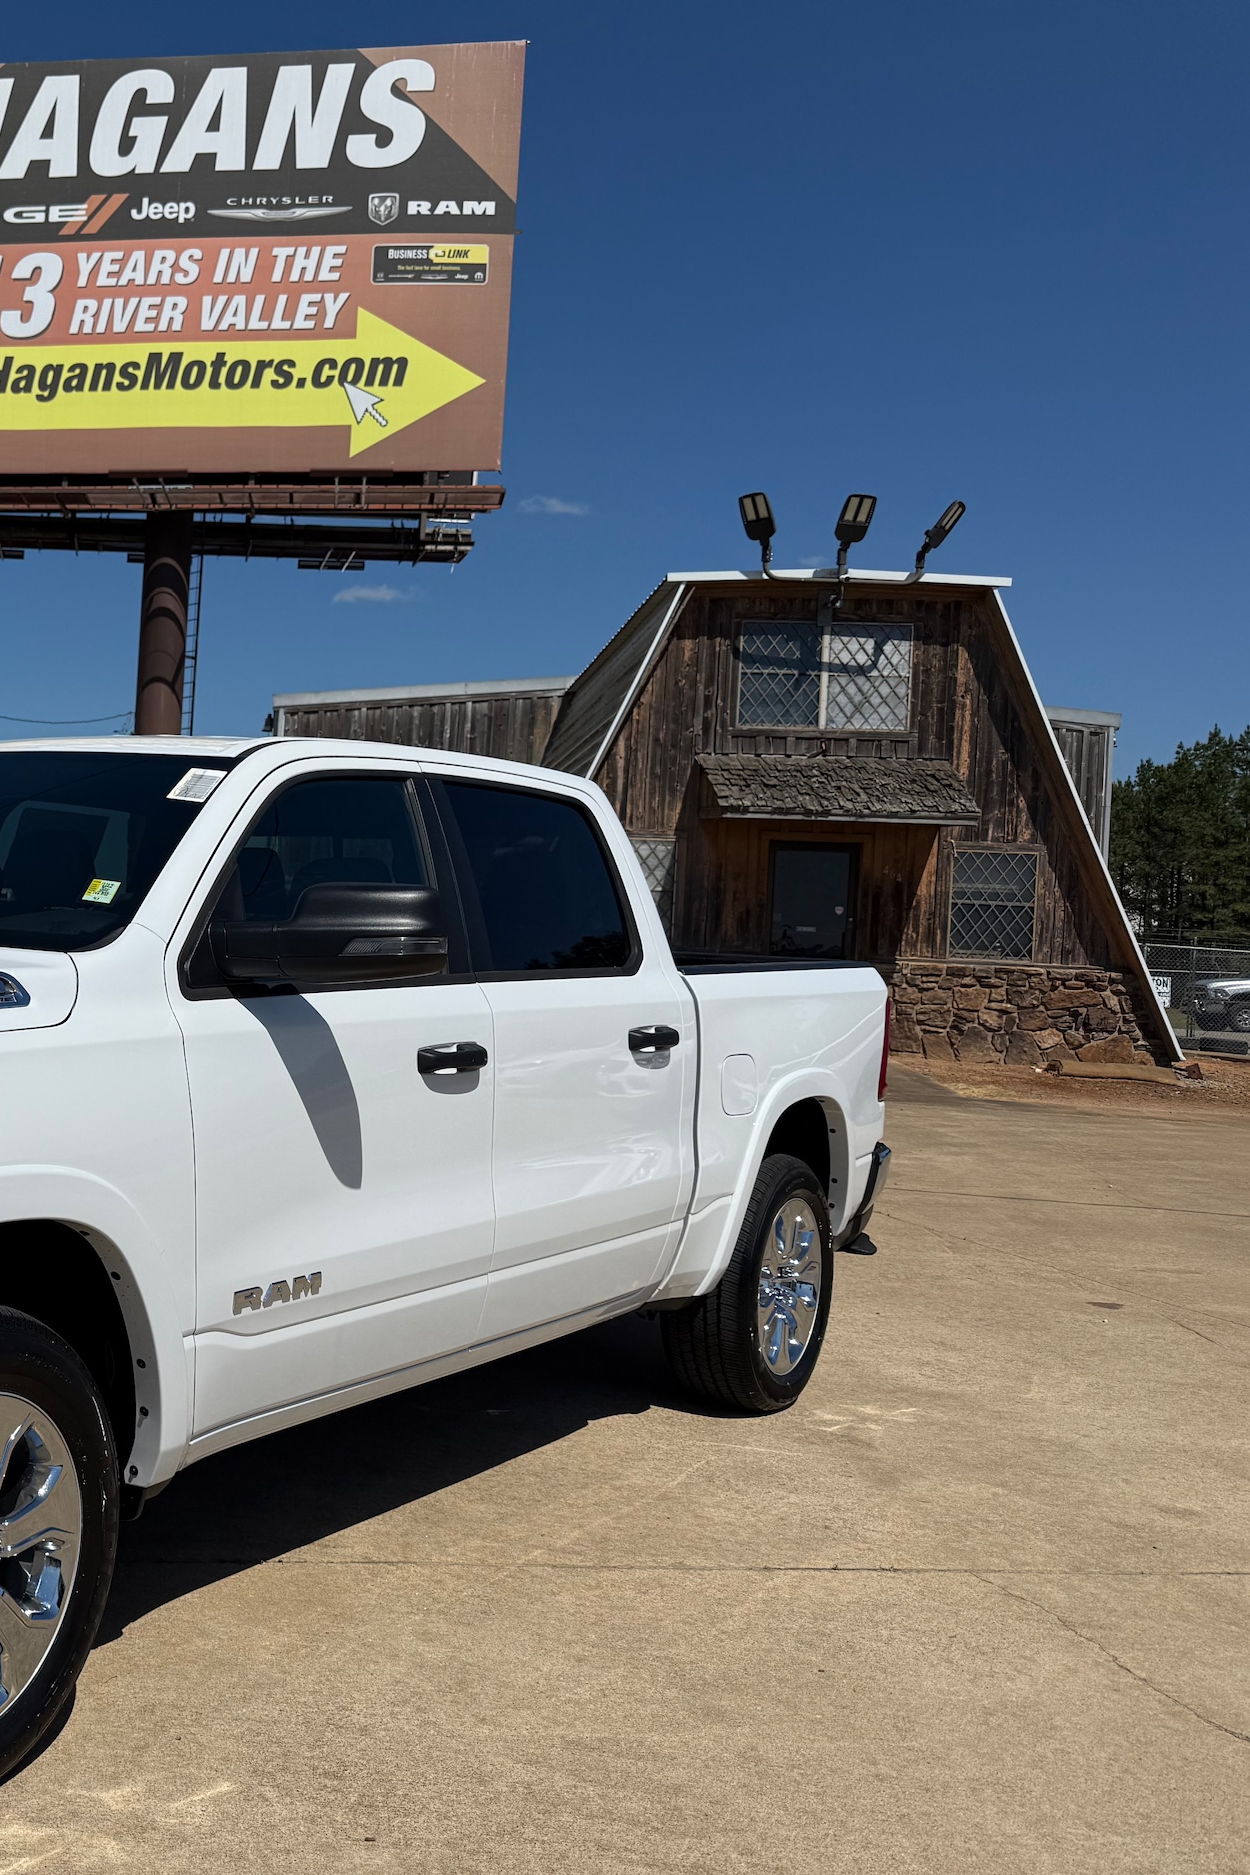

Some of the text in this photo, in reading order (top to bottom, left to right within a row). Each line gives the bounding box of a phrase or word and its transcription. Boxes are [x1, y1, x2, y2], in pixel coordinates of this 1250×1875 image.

[130, 197, 196, 224] Jeep
[226, 195, 334, 206] CHRYSLER
[406, 200, 496, 216] RAM
[76, 245, 348, 288] YEARS IN THE
[387, 248, 471, 260] BUSINESS LINK
[69, 292, 352, 335] RIVER VALLEY
[232, 1271, 322, 1316] RAM
